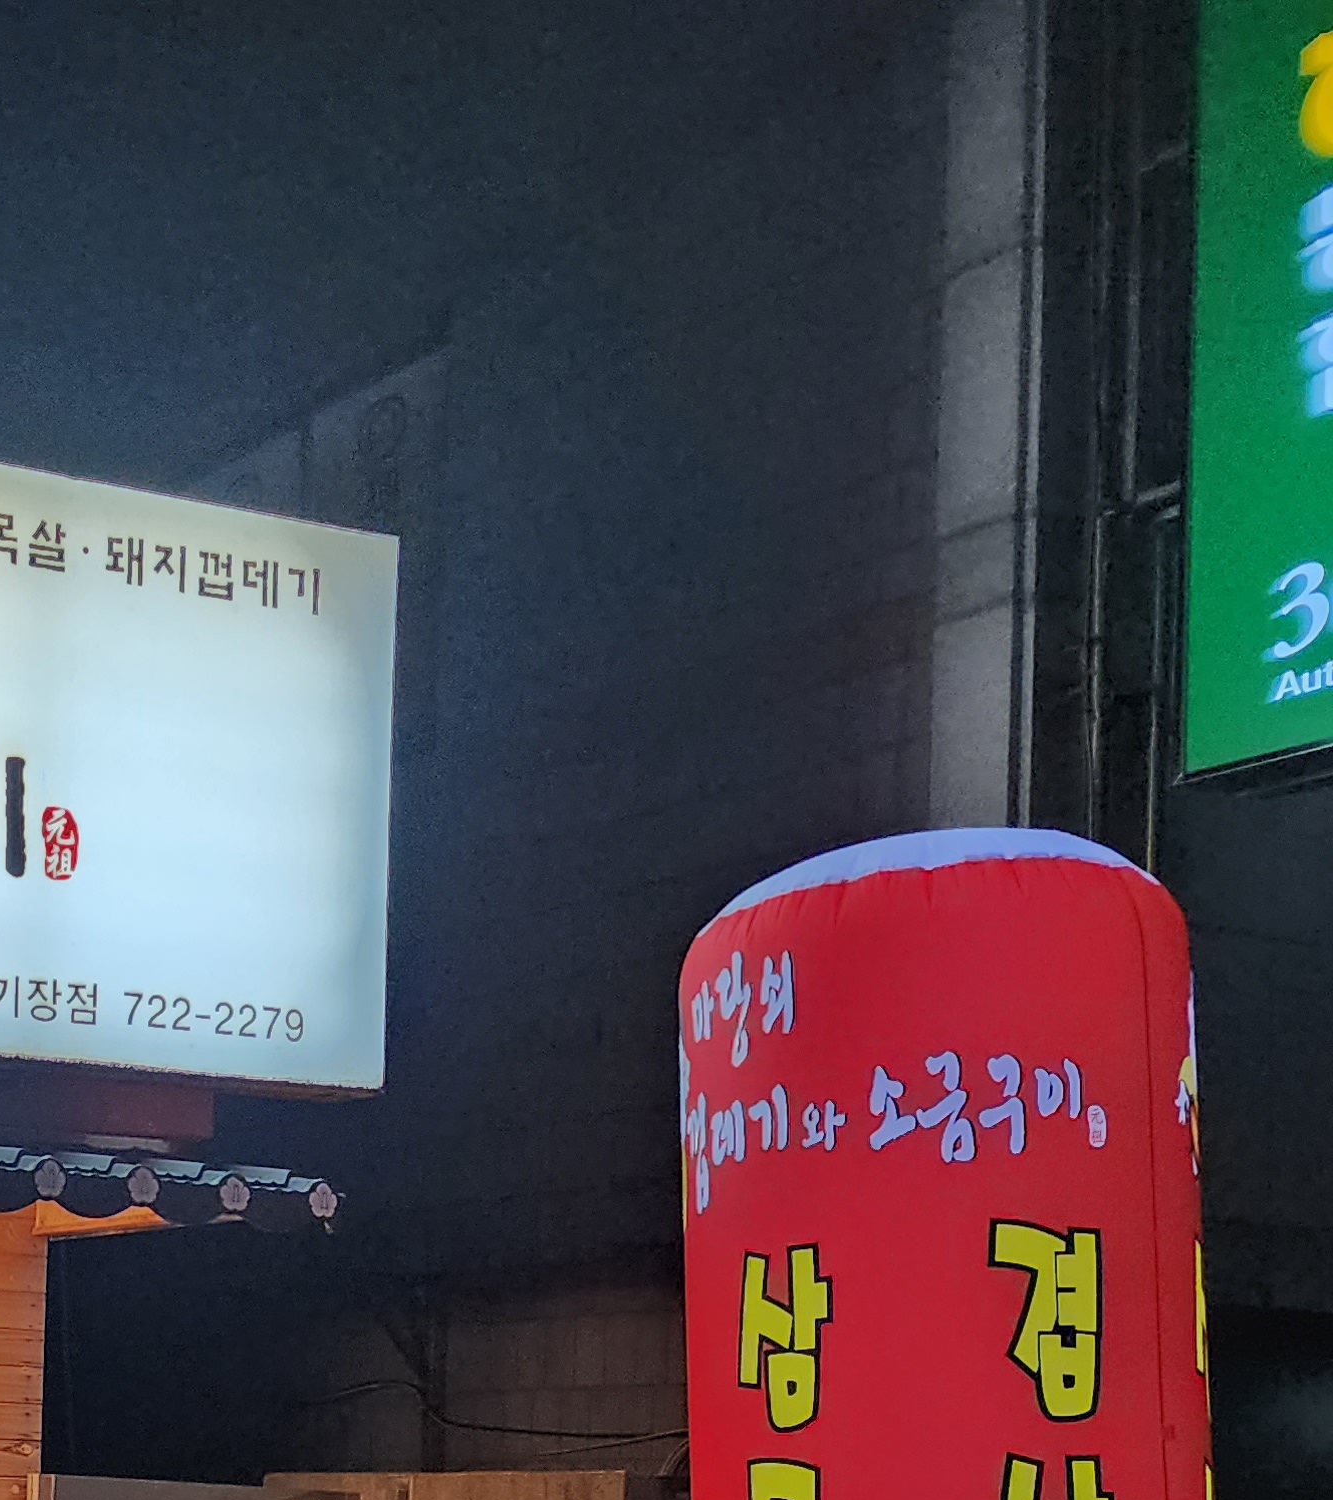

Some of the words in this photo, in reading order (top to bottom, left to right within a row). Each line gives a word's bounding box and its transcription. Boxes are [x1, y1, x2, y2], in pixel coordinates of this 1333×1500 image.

[105, 538, 321, 616] 돼지껍데기
[124, 989, 305, 1044] 722-2279
[691, 950, 796, 1067] 마당쇠
